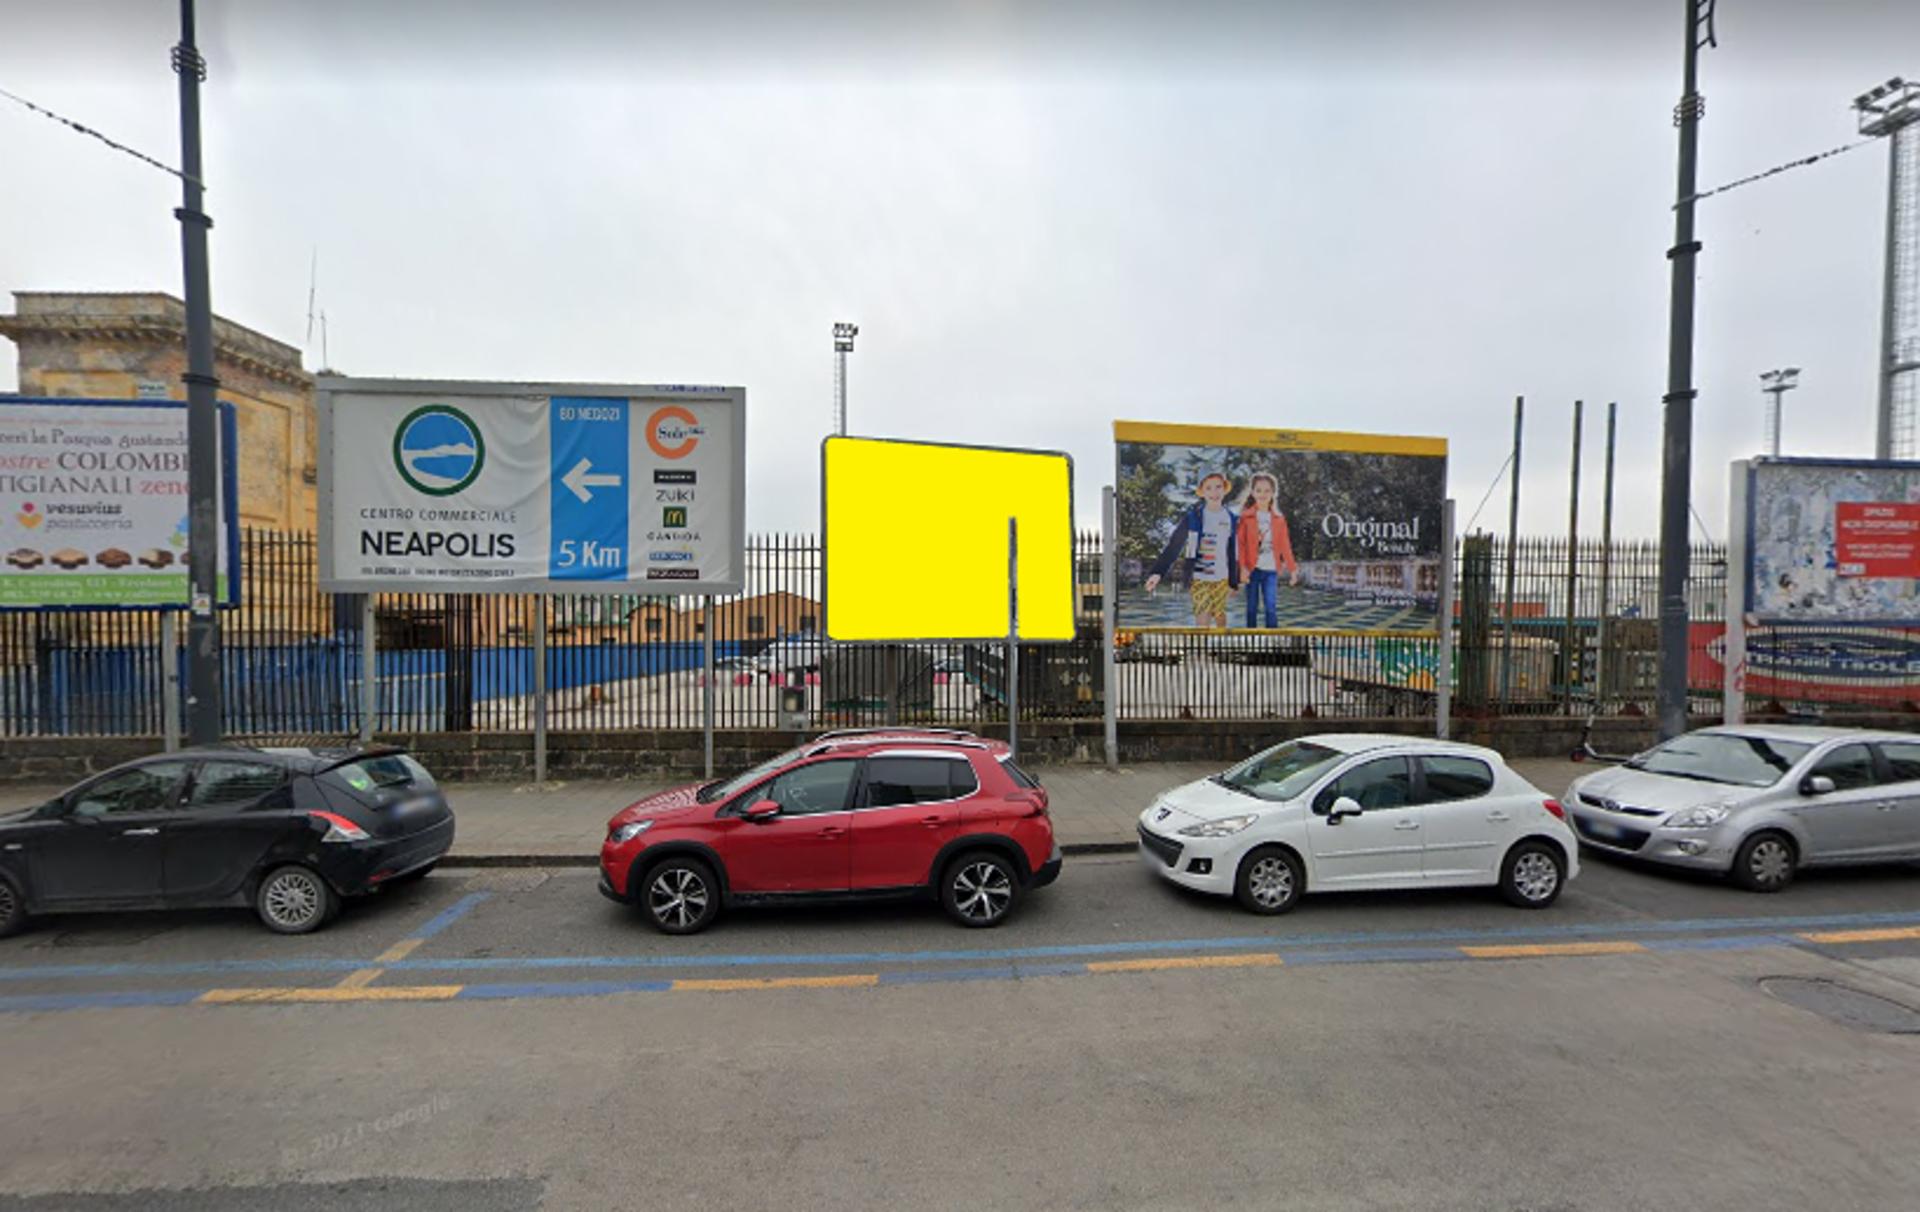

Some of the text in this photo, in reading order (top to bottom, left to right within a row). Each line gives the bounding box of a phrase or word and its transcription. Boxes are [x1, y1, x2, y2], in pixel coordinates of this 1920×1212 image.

[119, 431, 188, 449] gustand
[360, 507, 517, 523] CENTRO COMMERCIALE
[361, 530, 515, 558] NEAPOLIS
[1321, 512, 1420, 548] Original
[557, 540, 621, 569] 5 Km
